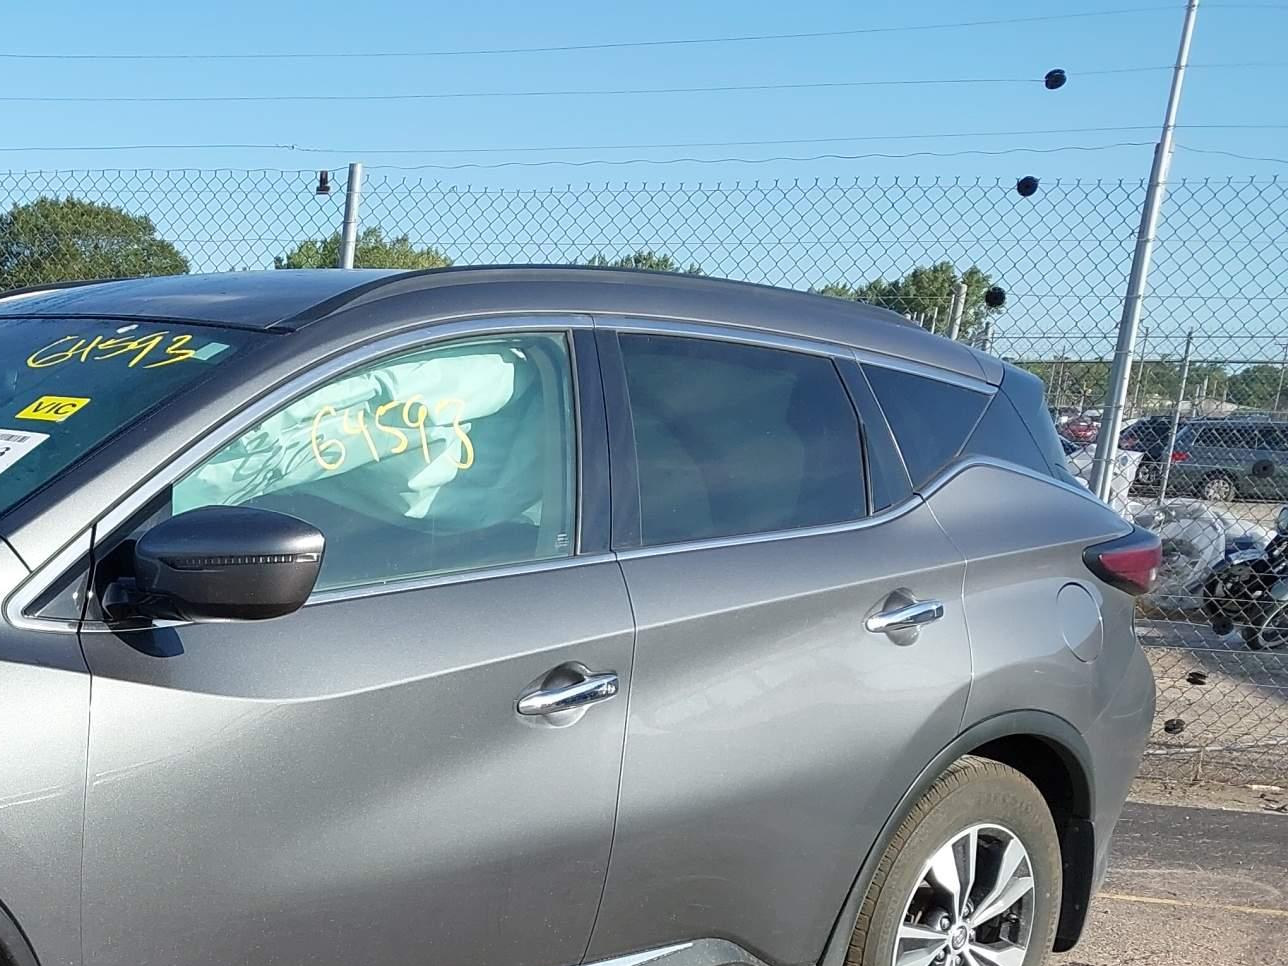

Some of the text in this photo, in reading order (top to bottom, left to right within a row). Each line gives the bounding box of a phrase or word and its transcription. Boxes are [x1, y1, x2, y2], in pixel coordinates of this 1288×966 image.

[27, 331, 196, 368] 64593
[31, 400, 77, 415] VIC
[312, 394, 474, 469] 64593
